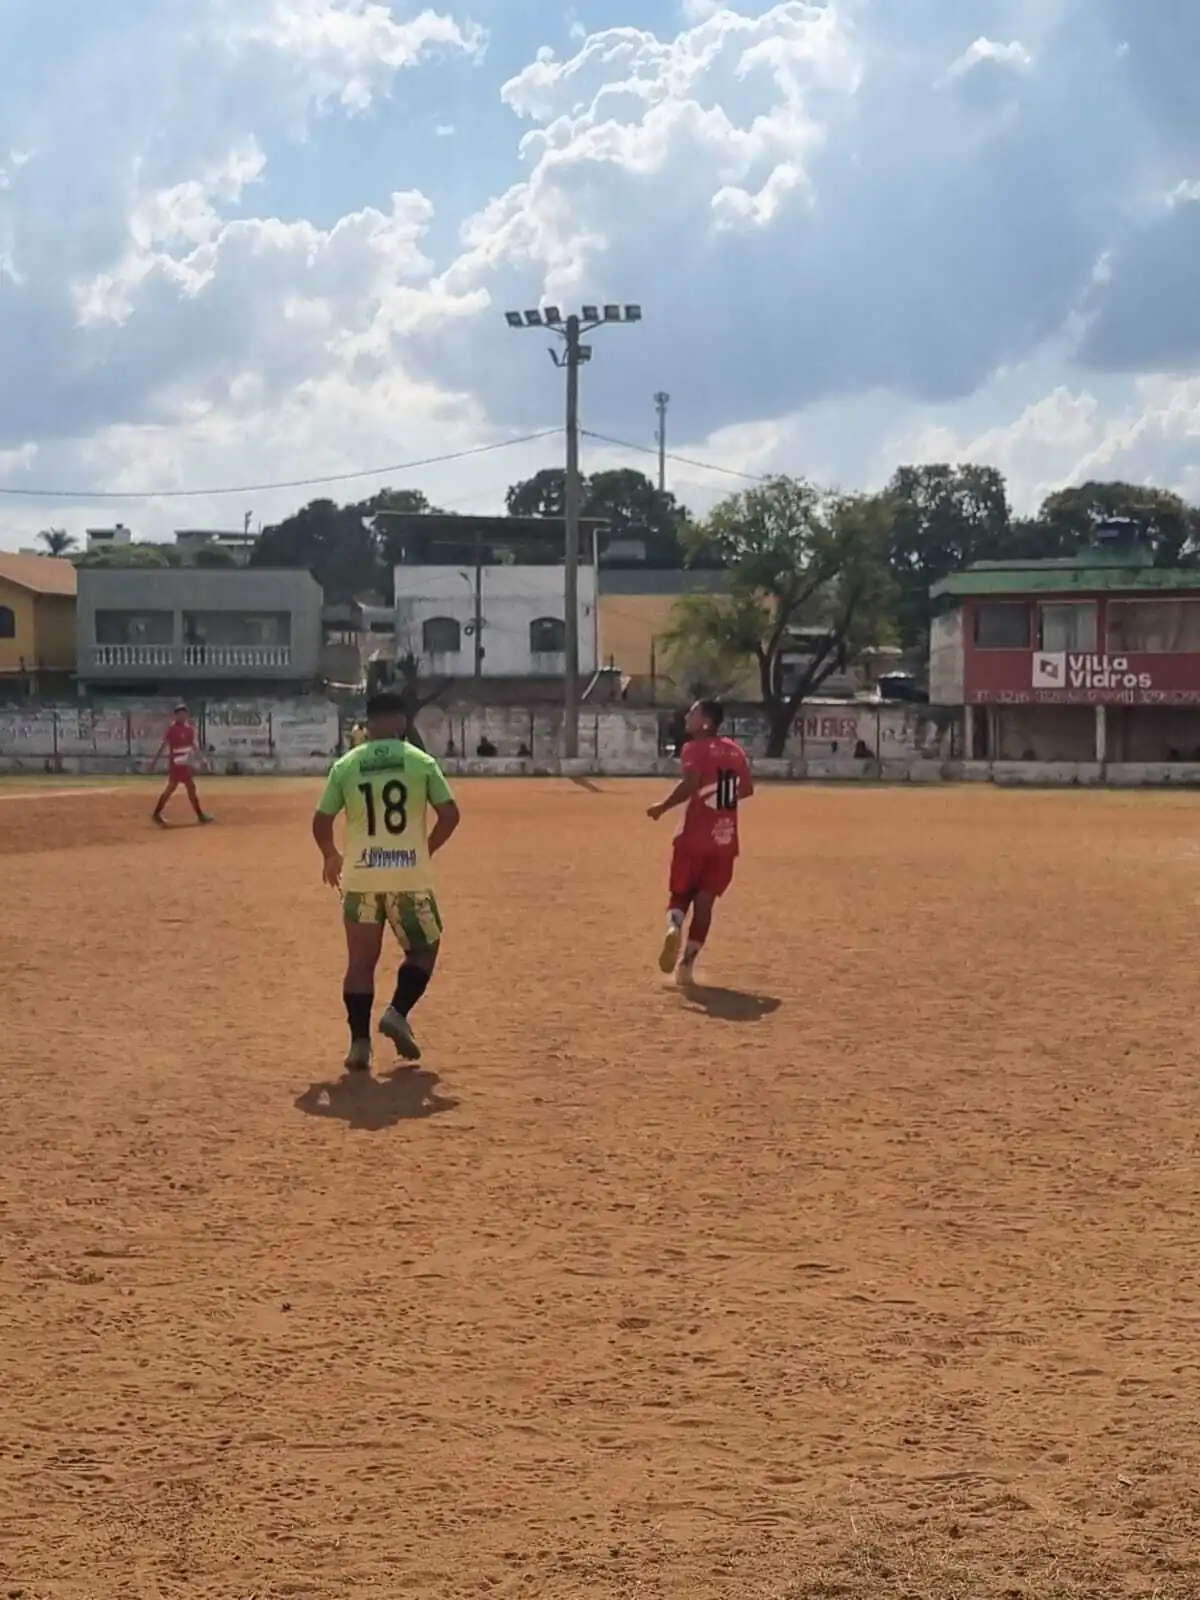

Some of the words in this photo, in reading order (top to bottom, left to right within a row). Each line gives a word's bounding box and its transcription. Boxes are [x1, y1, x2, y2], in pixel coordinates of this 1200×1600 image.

[1069, 671, 1152, 688] Vidros
[358, 779, 407, 836] 18
[717, 769, 738, 809] 10
